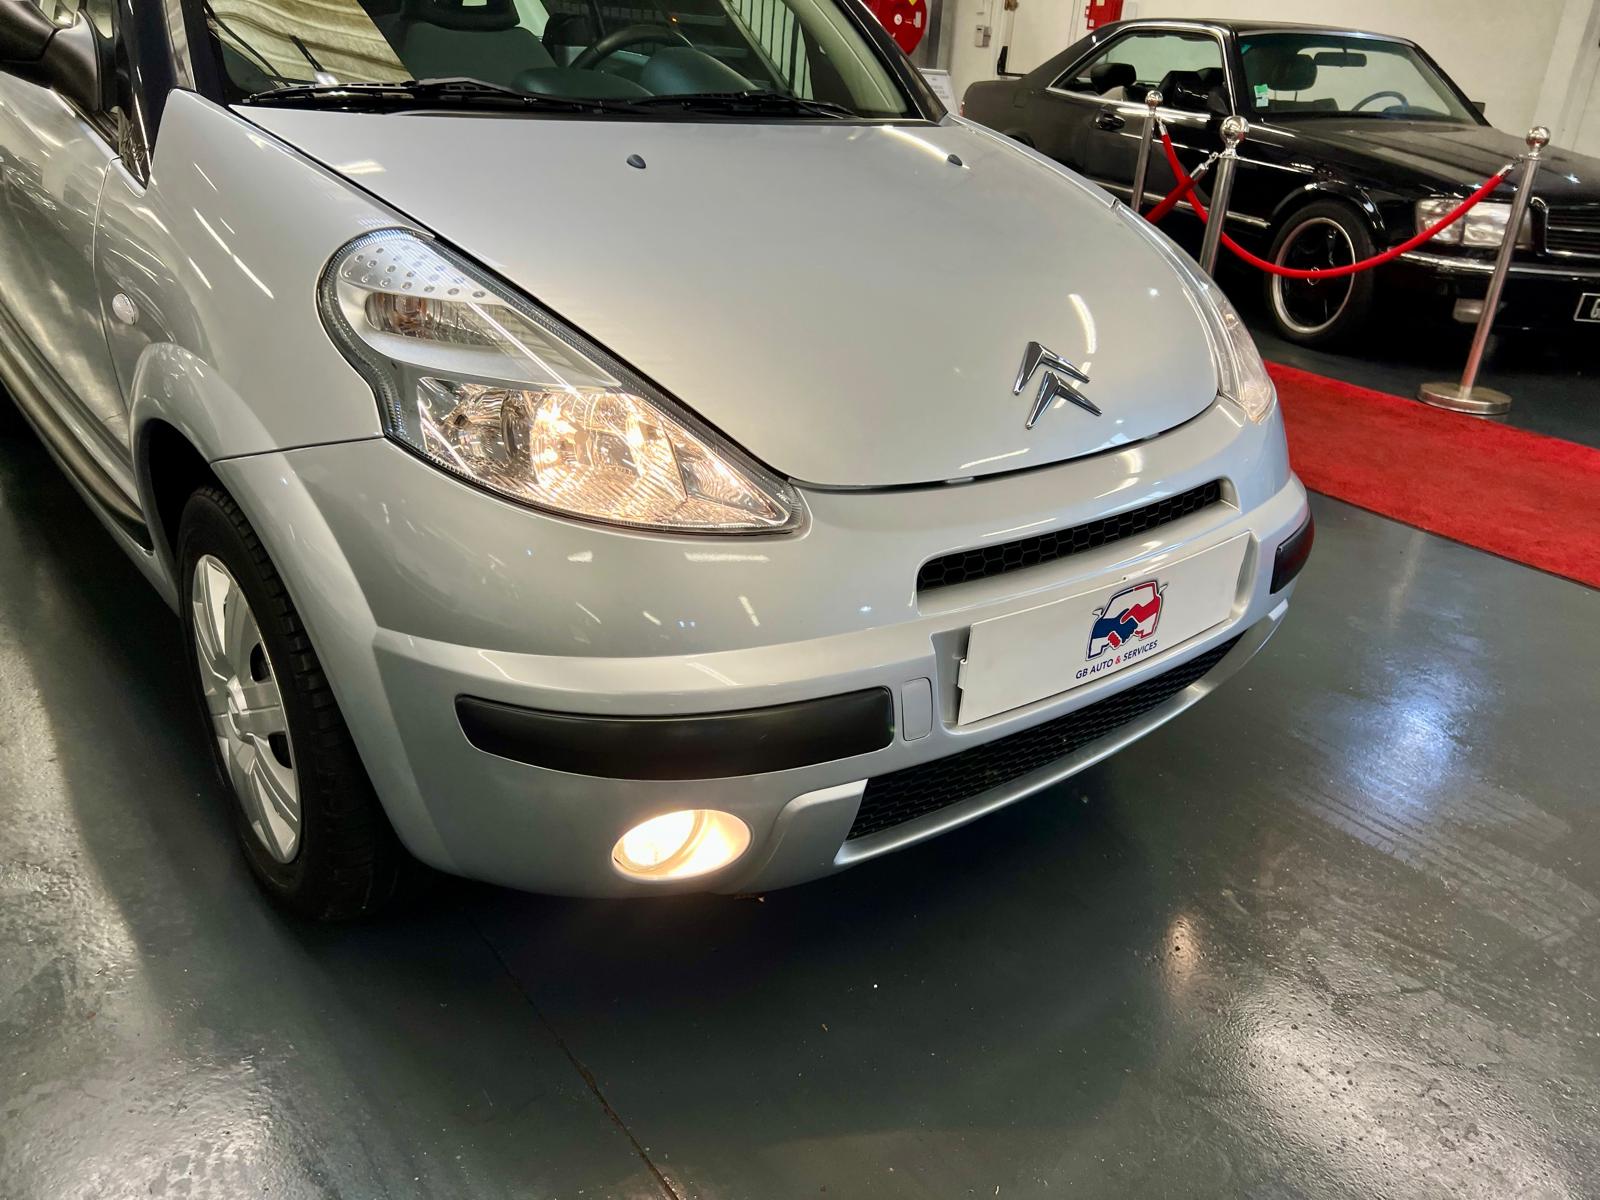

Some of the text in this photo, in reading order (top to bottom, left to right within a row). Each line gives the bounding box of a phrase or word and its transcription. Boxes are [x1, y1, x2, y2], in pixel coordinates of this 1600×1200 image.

[1075, 640, 1158, 679] GB AUTO & SERVICES
